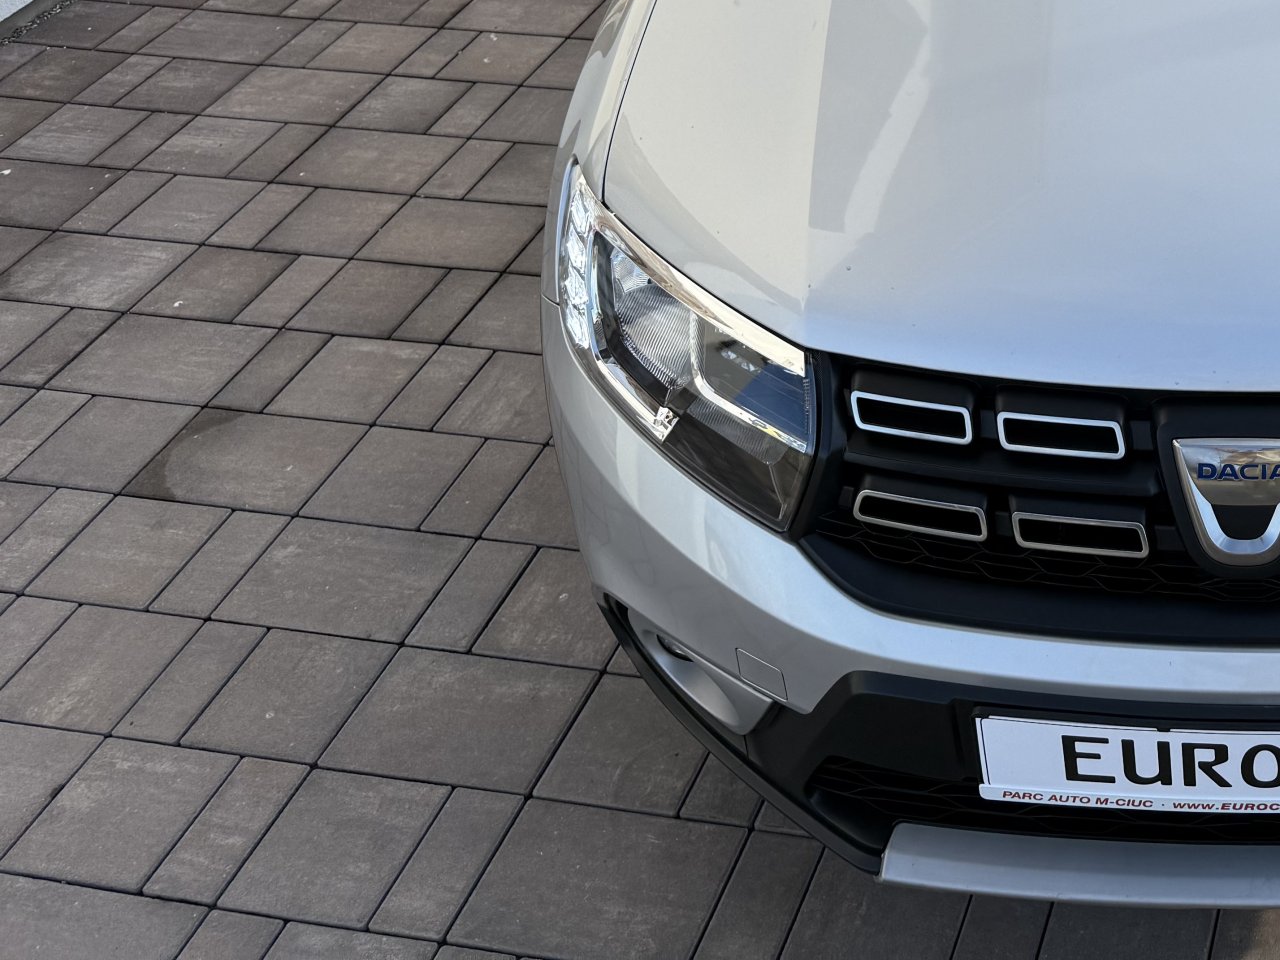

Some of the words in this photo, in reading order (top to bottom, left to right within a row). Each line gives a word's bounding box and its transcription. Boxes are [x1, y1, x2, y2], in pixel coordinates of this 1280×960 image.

[1002, 790, 1044, 801] PARC
[1047, 793, 1091, 804] AUTO
[1095, 797, 1154, 808] M-CIUC
